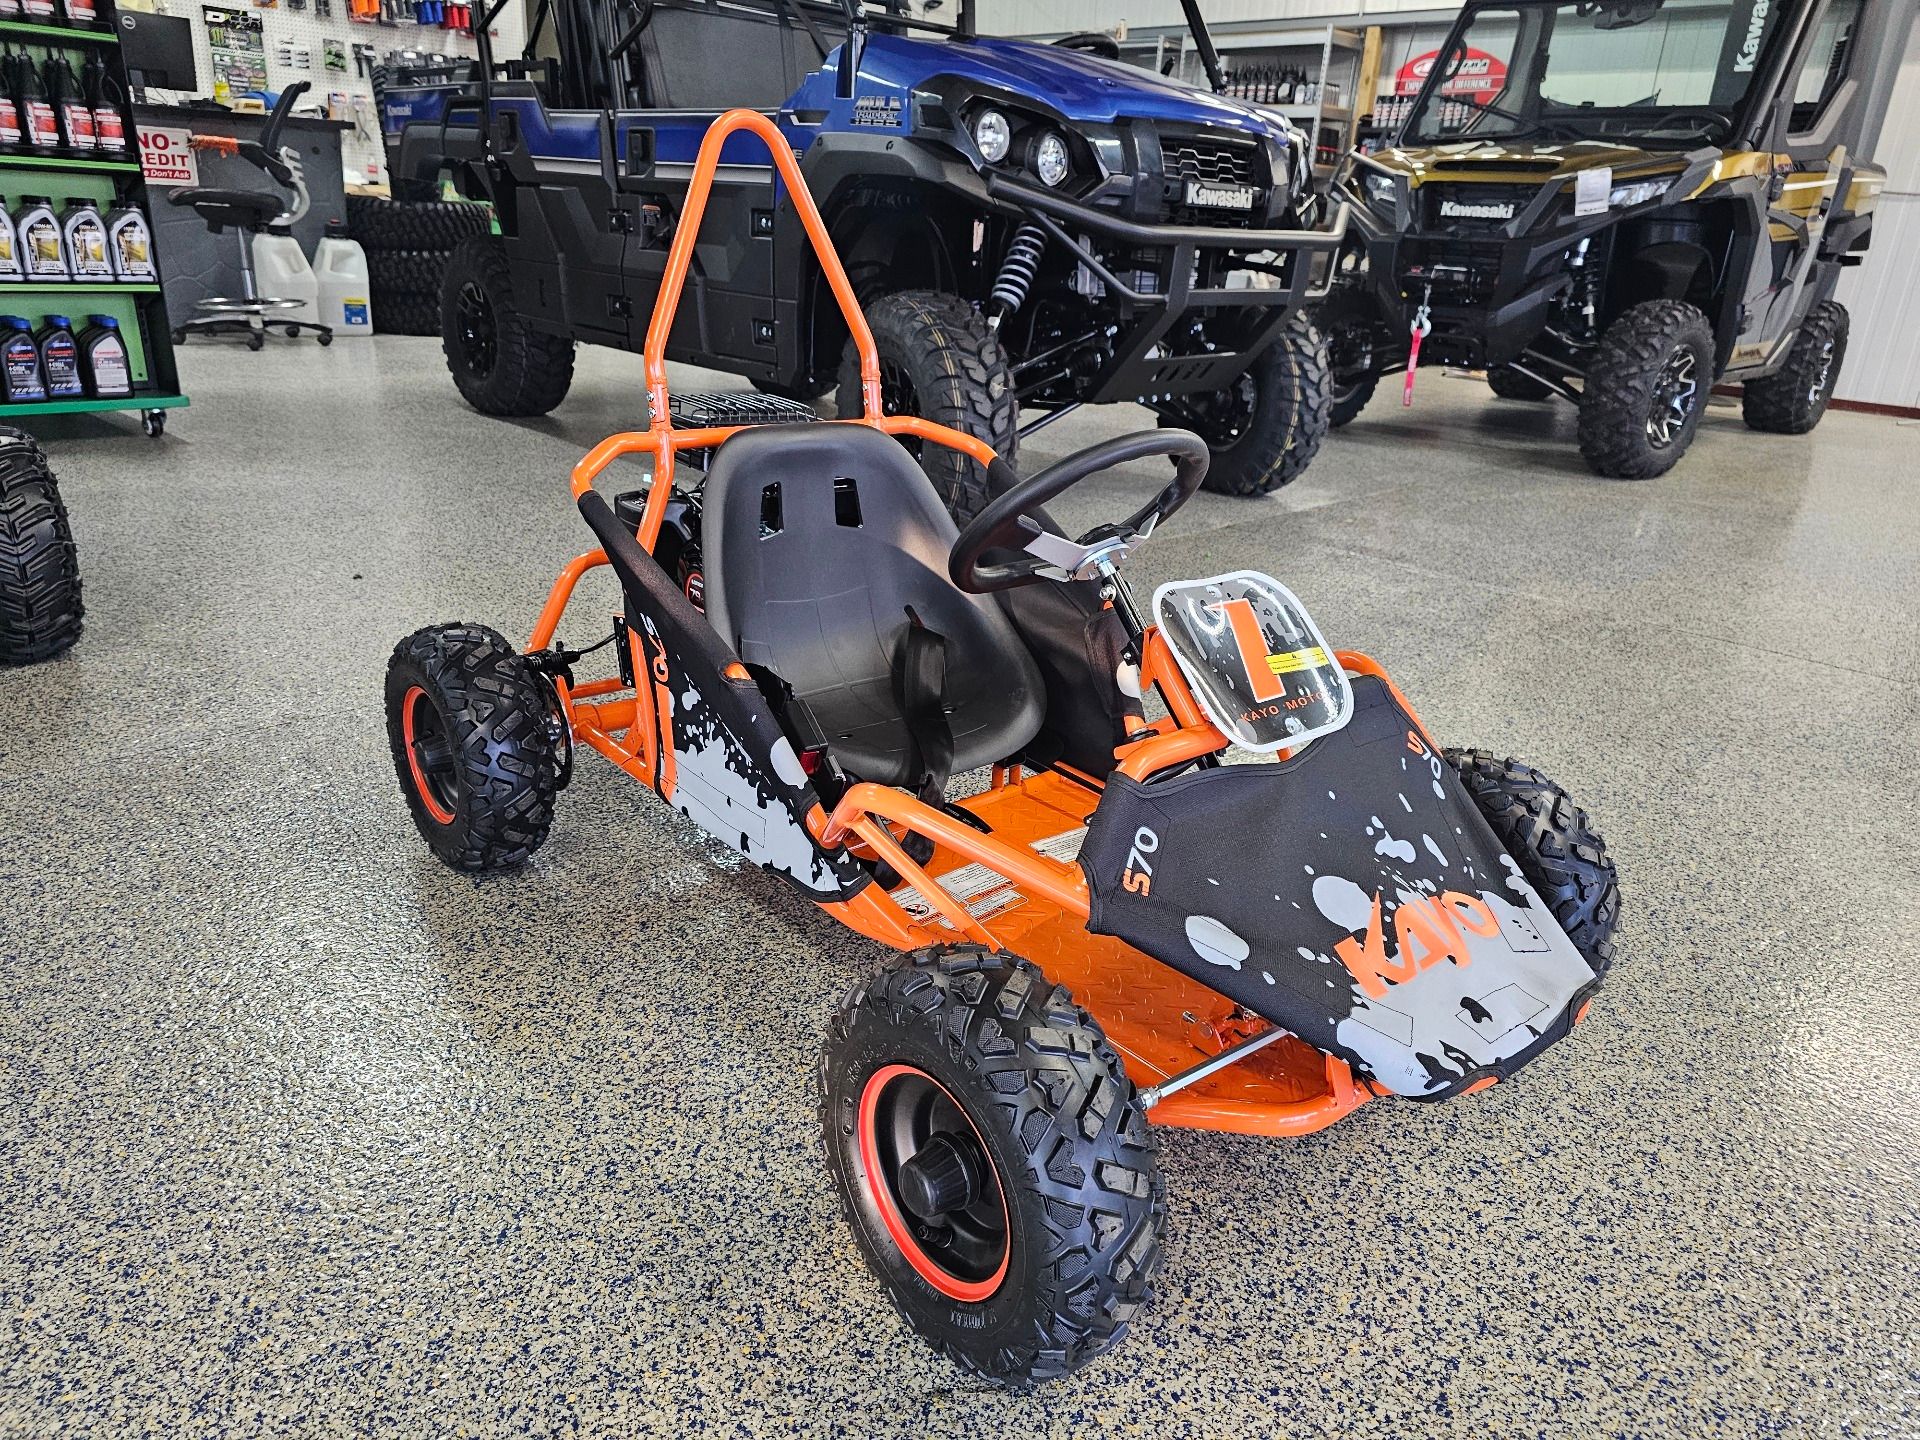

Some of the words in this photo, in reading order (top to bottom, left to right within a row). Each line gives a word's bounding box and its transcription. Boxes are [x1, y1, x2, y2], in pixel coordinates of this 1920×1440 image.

[1733, 0, 1769, 72] Kawa
[144, 152, 188, 167] EDIT
[151, 169, 172, 178] Don't
[174, 170, 190, 179] Ask
[1186, 182, 1253, 209] Kawasaki
[1440, 200, 1514, 219] Kawasaki
[1240, 704, 1281, 723] KAYO
[1406, 730, 1442, 780] S70
[1122, 825, 1159, 898] S70
[1333, 889, 1500, 1001] KAYO
